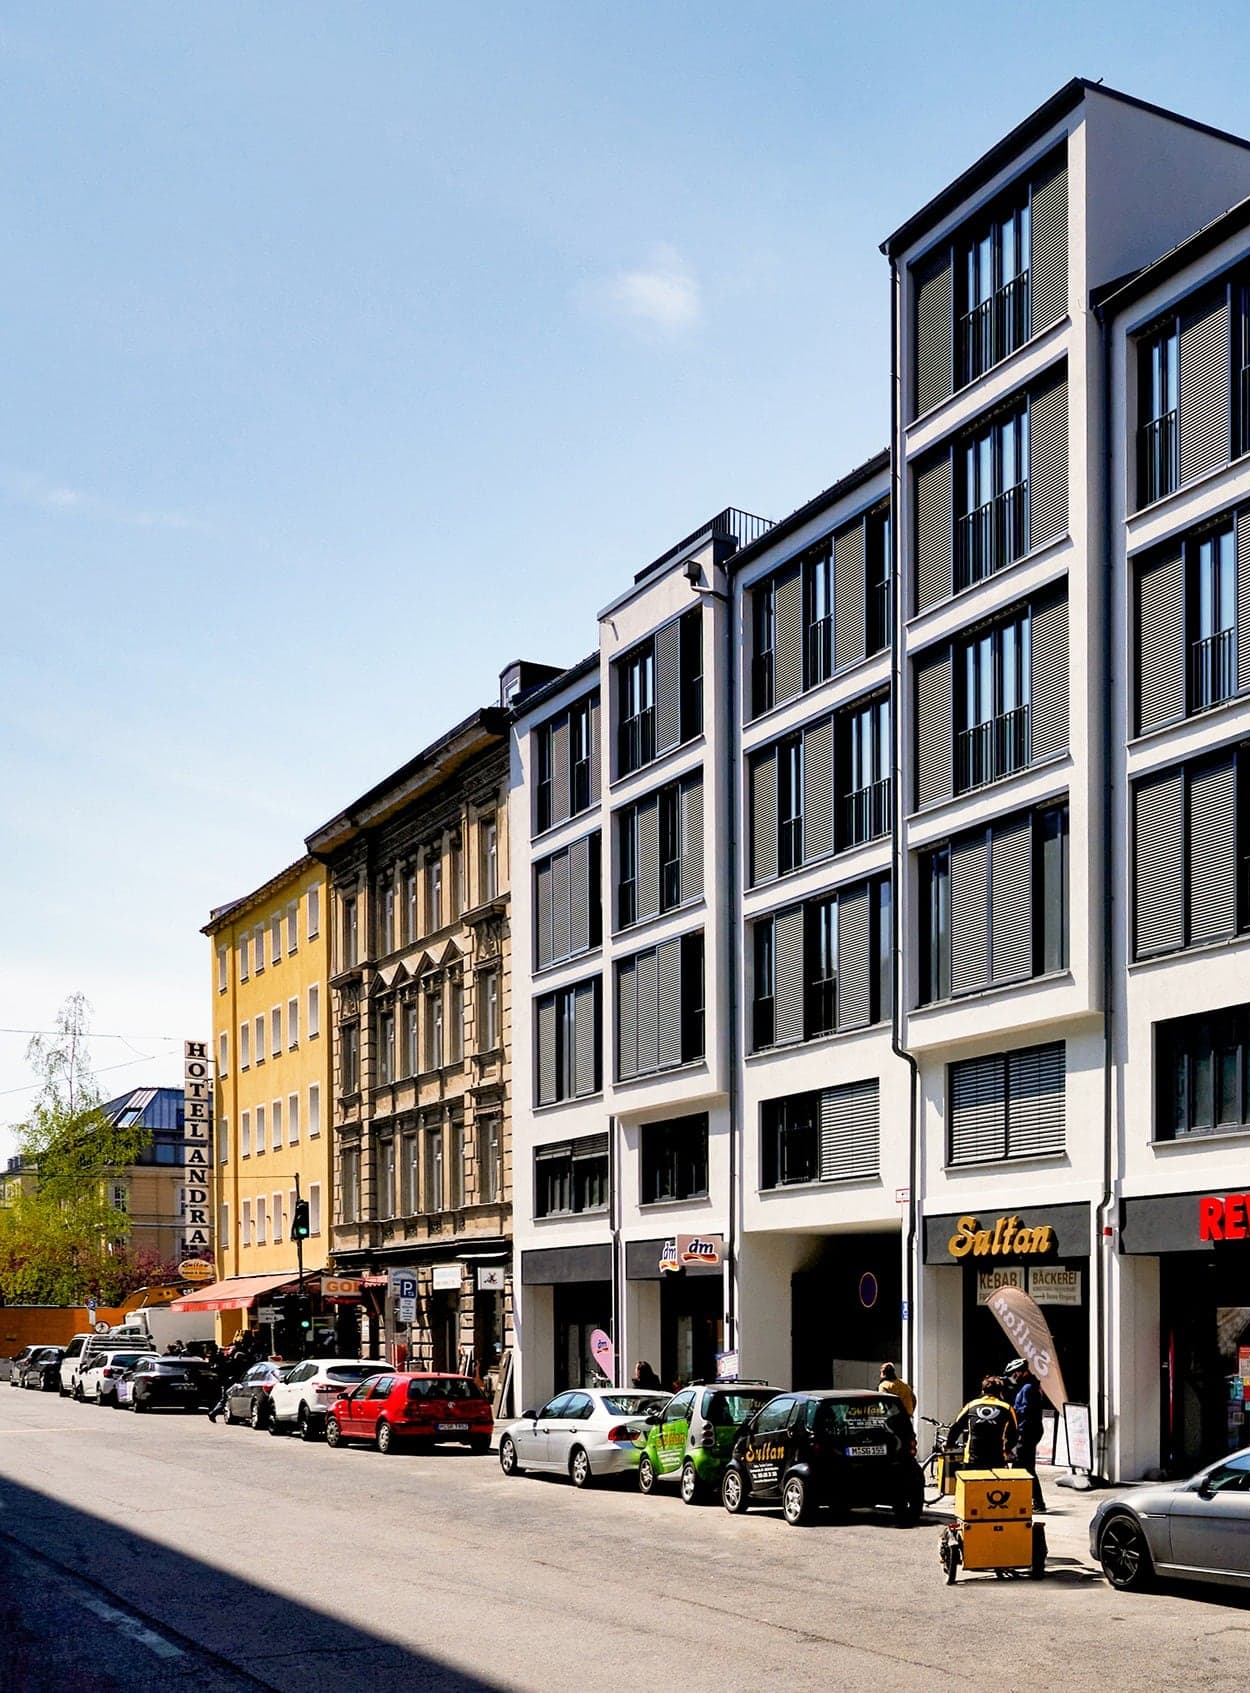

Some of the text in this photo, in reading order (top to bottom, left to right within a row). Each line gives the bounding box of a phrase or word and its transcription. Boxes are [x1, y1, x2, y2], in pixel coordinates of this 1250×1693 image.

[188, 1042, 207, 1243] HOTEL ANDRA
[948, 1216, 1052, 1257] Sultan
[689, 1239, 713, 1254] dm
[403, 1281, 413, 1296] P
[979, 1272, 1018, 1289] KEBAB
[746, 1441, 785, 1462] Sultan
